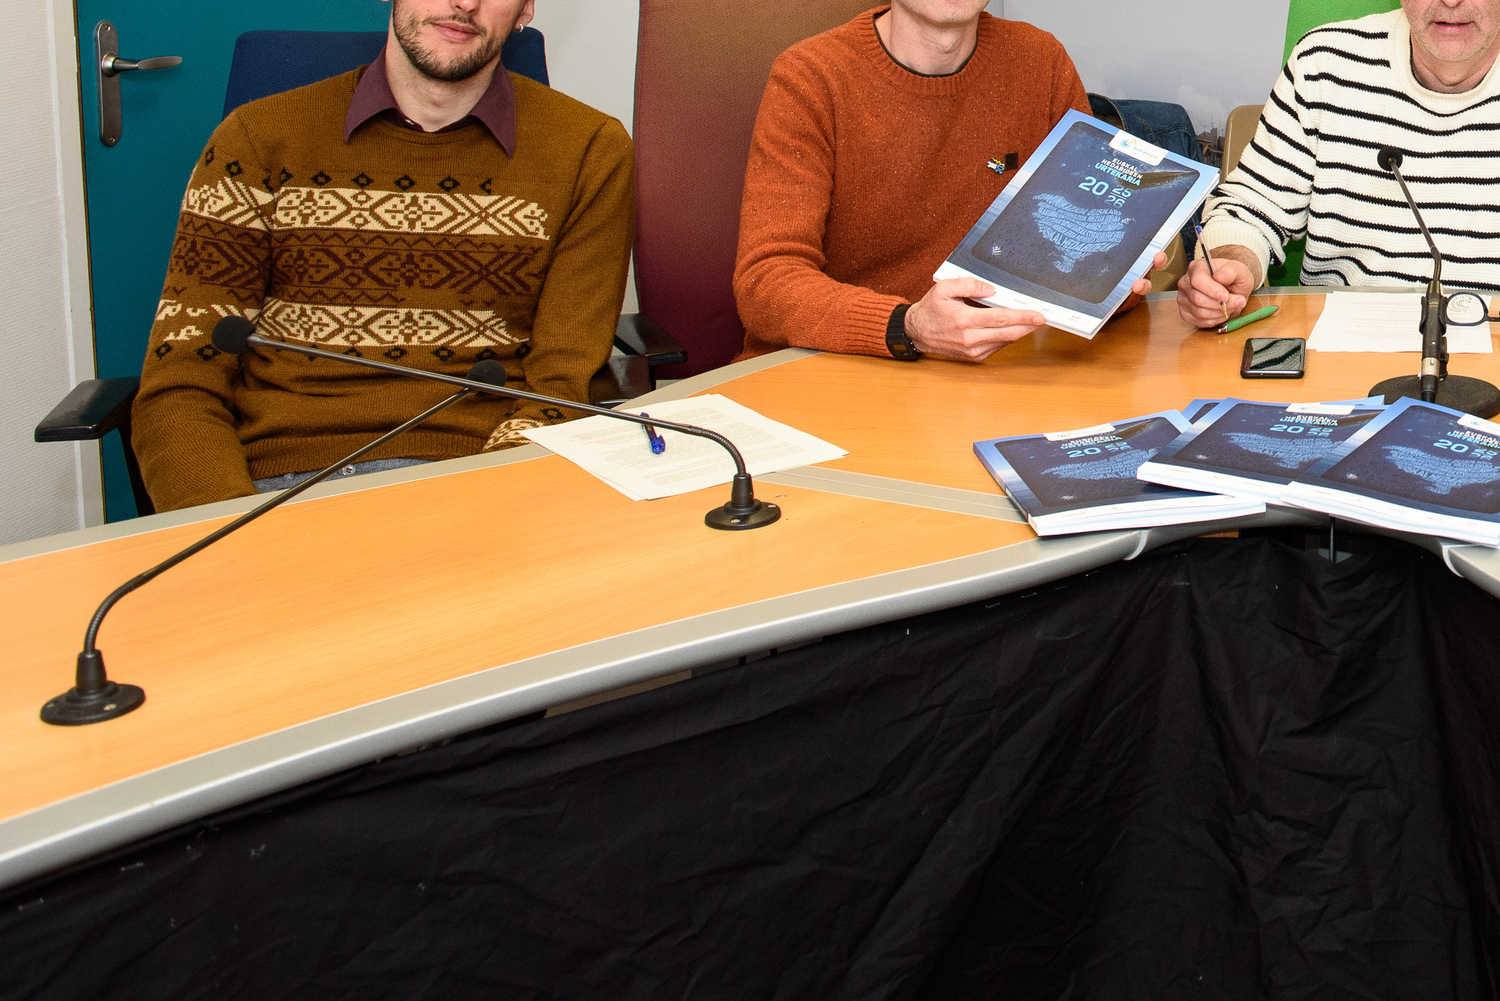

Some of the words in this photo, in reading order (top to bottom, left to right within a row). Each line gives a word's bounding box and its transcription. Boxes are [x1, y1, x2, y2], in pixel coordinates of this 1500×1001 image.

[1112, 158, 1138, 171] EUSKAL
[1095, 163, 1141, 186] URTEKARIA
[1078, 176, 1109, 196] 20
[1112, 185, 1132, 198] 25
[1270, 424, 1304, 433] 20
[1066, 447, 1102, 458] 20
[1433, 439, 1469, 453] 20
